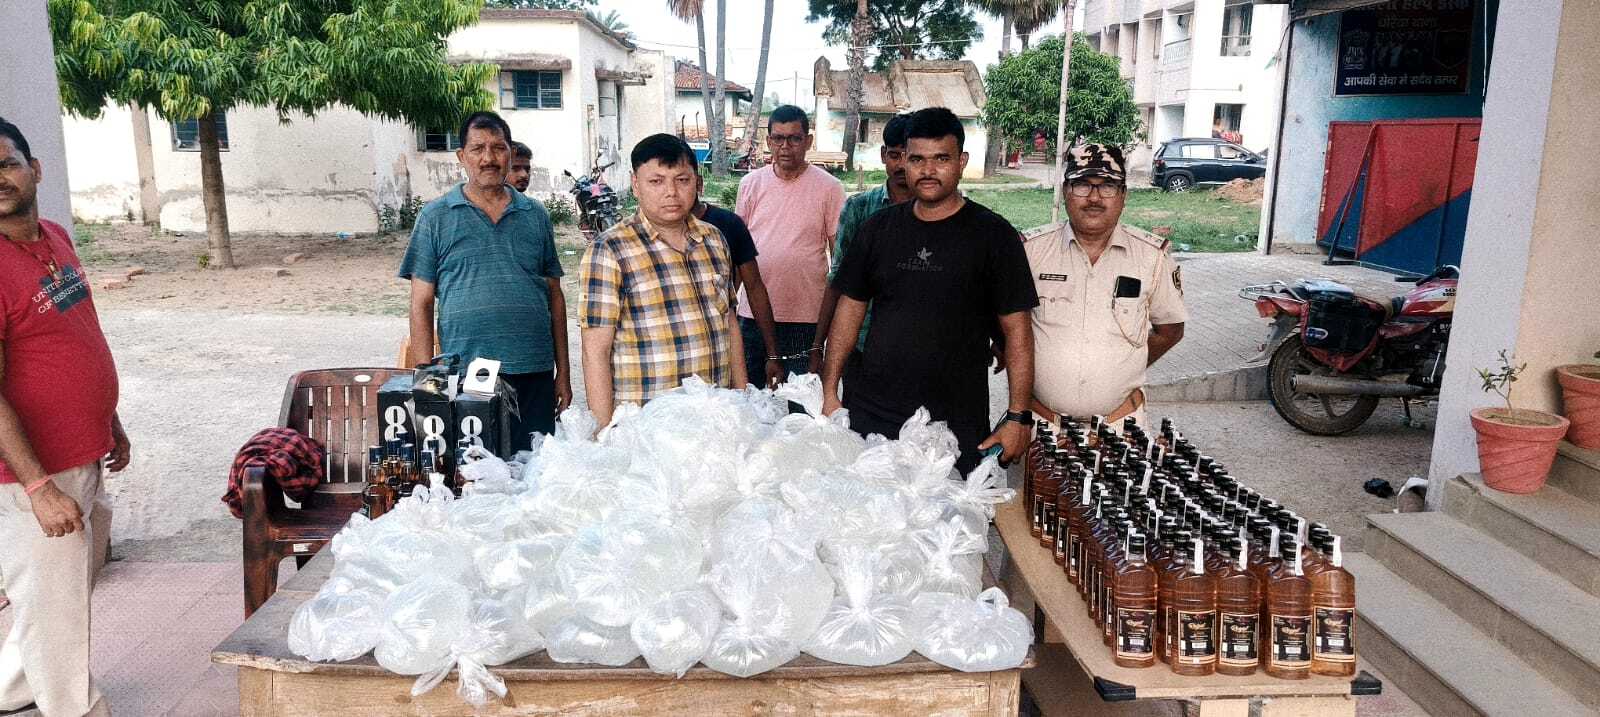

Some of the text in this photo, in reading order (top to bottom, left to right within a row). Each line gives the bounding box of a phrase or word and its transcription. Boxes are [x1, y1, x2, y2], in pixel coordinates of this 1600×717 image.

[1344, 73, 1376, 87] आपकी
[1378, 73, 1397, 87] सेवा
[384, 405, 408, 442] 8
[423, 415, 447, 456] 8
[460, 416, 484, 449] 8
